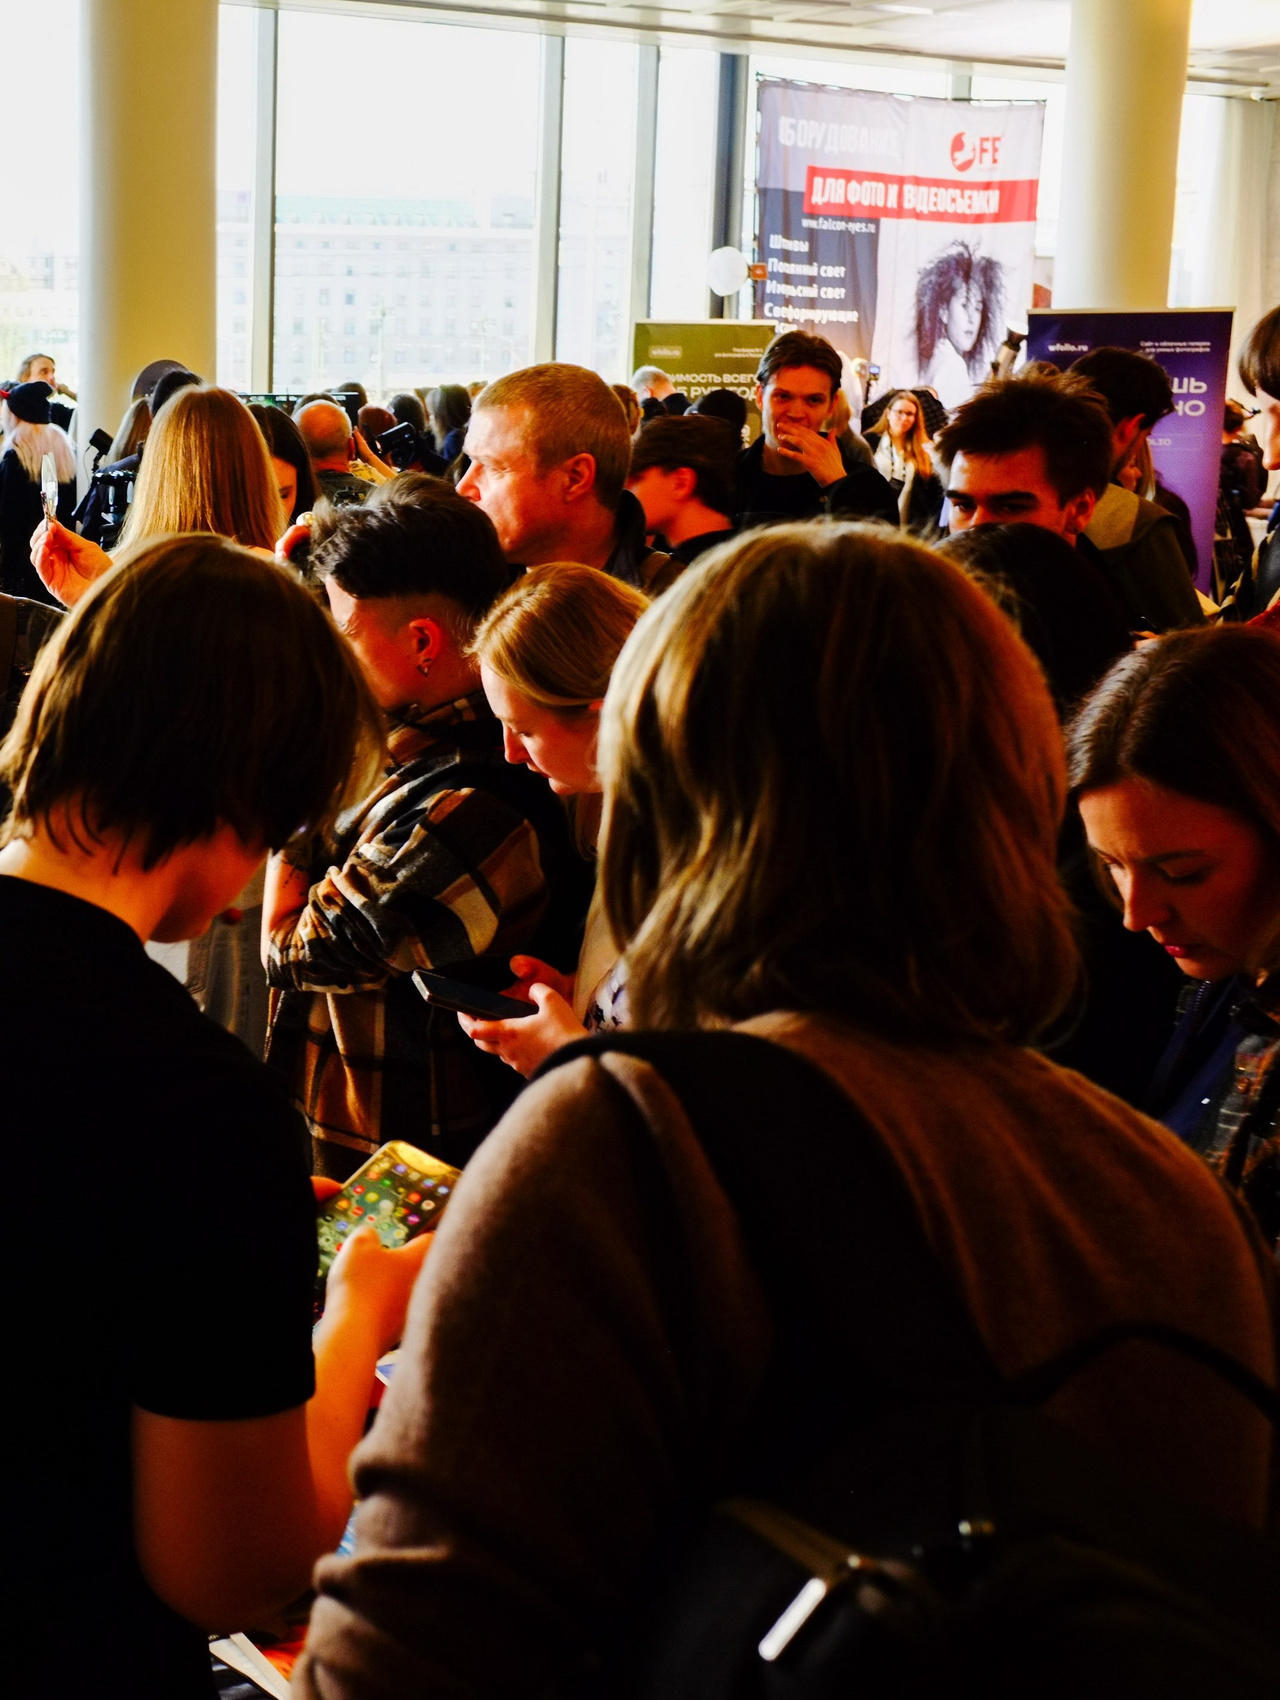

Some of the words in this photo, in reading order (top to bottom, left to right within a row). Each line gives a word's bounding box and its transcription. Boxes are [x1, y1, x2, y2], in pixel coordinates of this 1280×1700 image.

[979, 136, 1002, 164] FE
[811, 176, 845, 205] ДЛЯ
[847, 180, 885, 207] ФОТО
[820, 265, 846, 278] свет
[820, 287, 846, 299] свет
[668, 373, 721, 383] ИМОСТЬ
